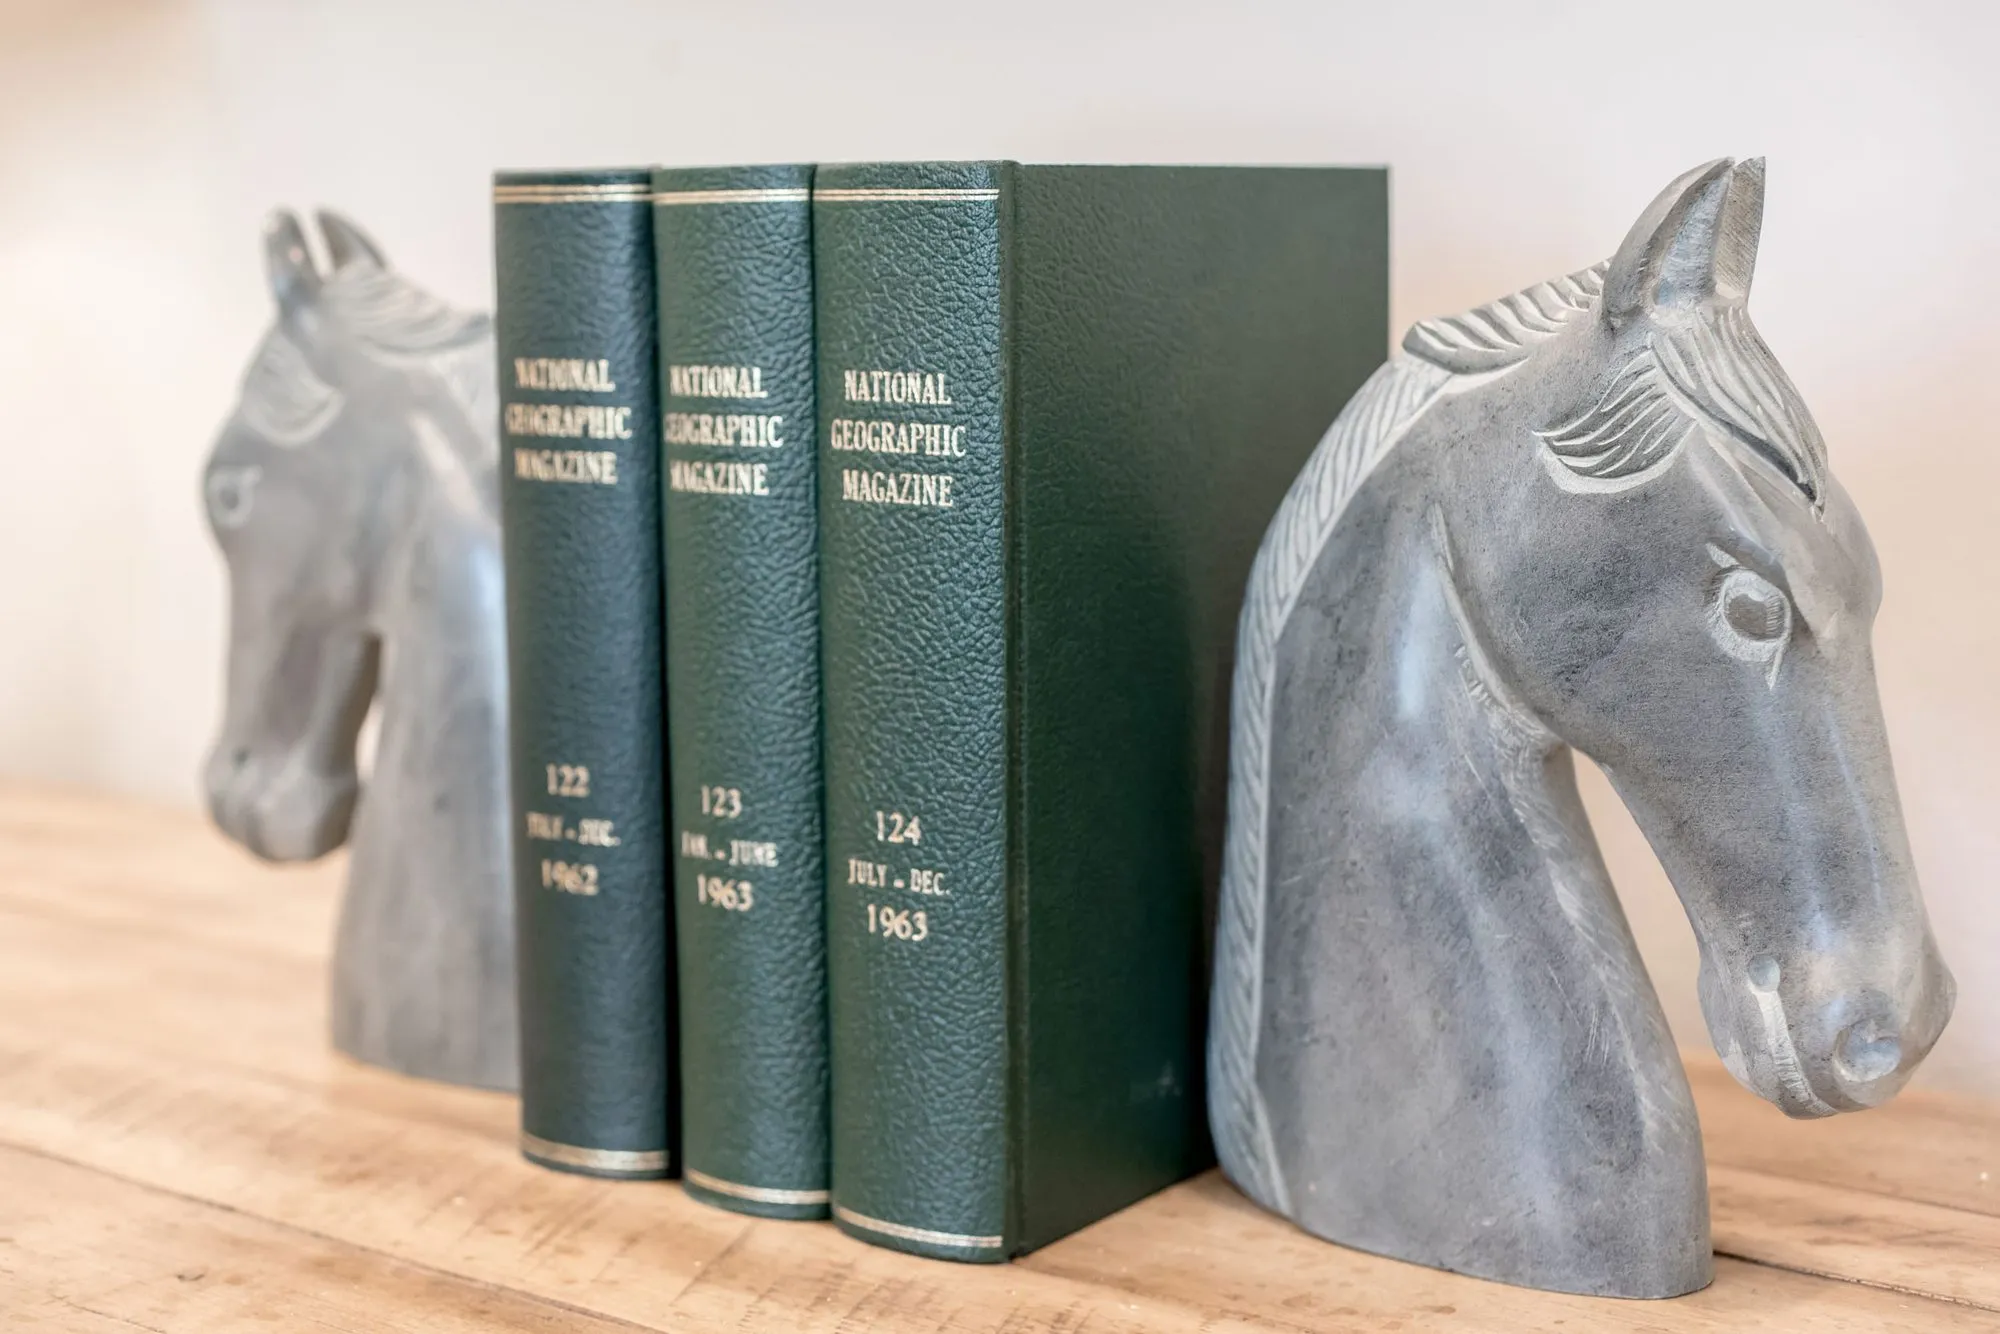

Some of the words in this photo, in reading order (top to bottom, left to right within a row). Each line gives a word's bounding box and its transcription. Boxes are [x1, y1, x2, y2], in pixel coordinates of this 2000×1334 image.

[669, 365, 769, 398] NATIONAL
[844, 369, 952, 405] NATIONAL
[663, 413, 784, 448] GEOGRAPHIC
[831, 418, 967, 457] GEOGRAPHIC
[670, 461, 770, 496] MAGAZINE
[842, 468, 954, 507] MAGAZINE
[546, 763, 591, 798] 122
[701, 785, 743, 819] 123
[876, 810, 922, 846] 124
[541, 859, 599, 896] 1962
[696, 873, 754, 912] 1963
[847, 857, 888, 888] JULY
[910, 868, 952, 896] DEC.
[867, 903, 928, 941] 1963
